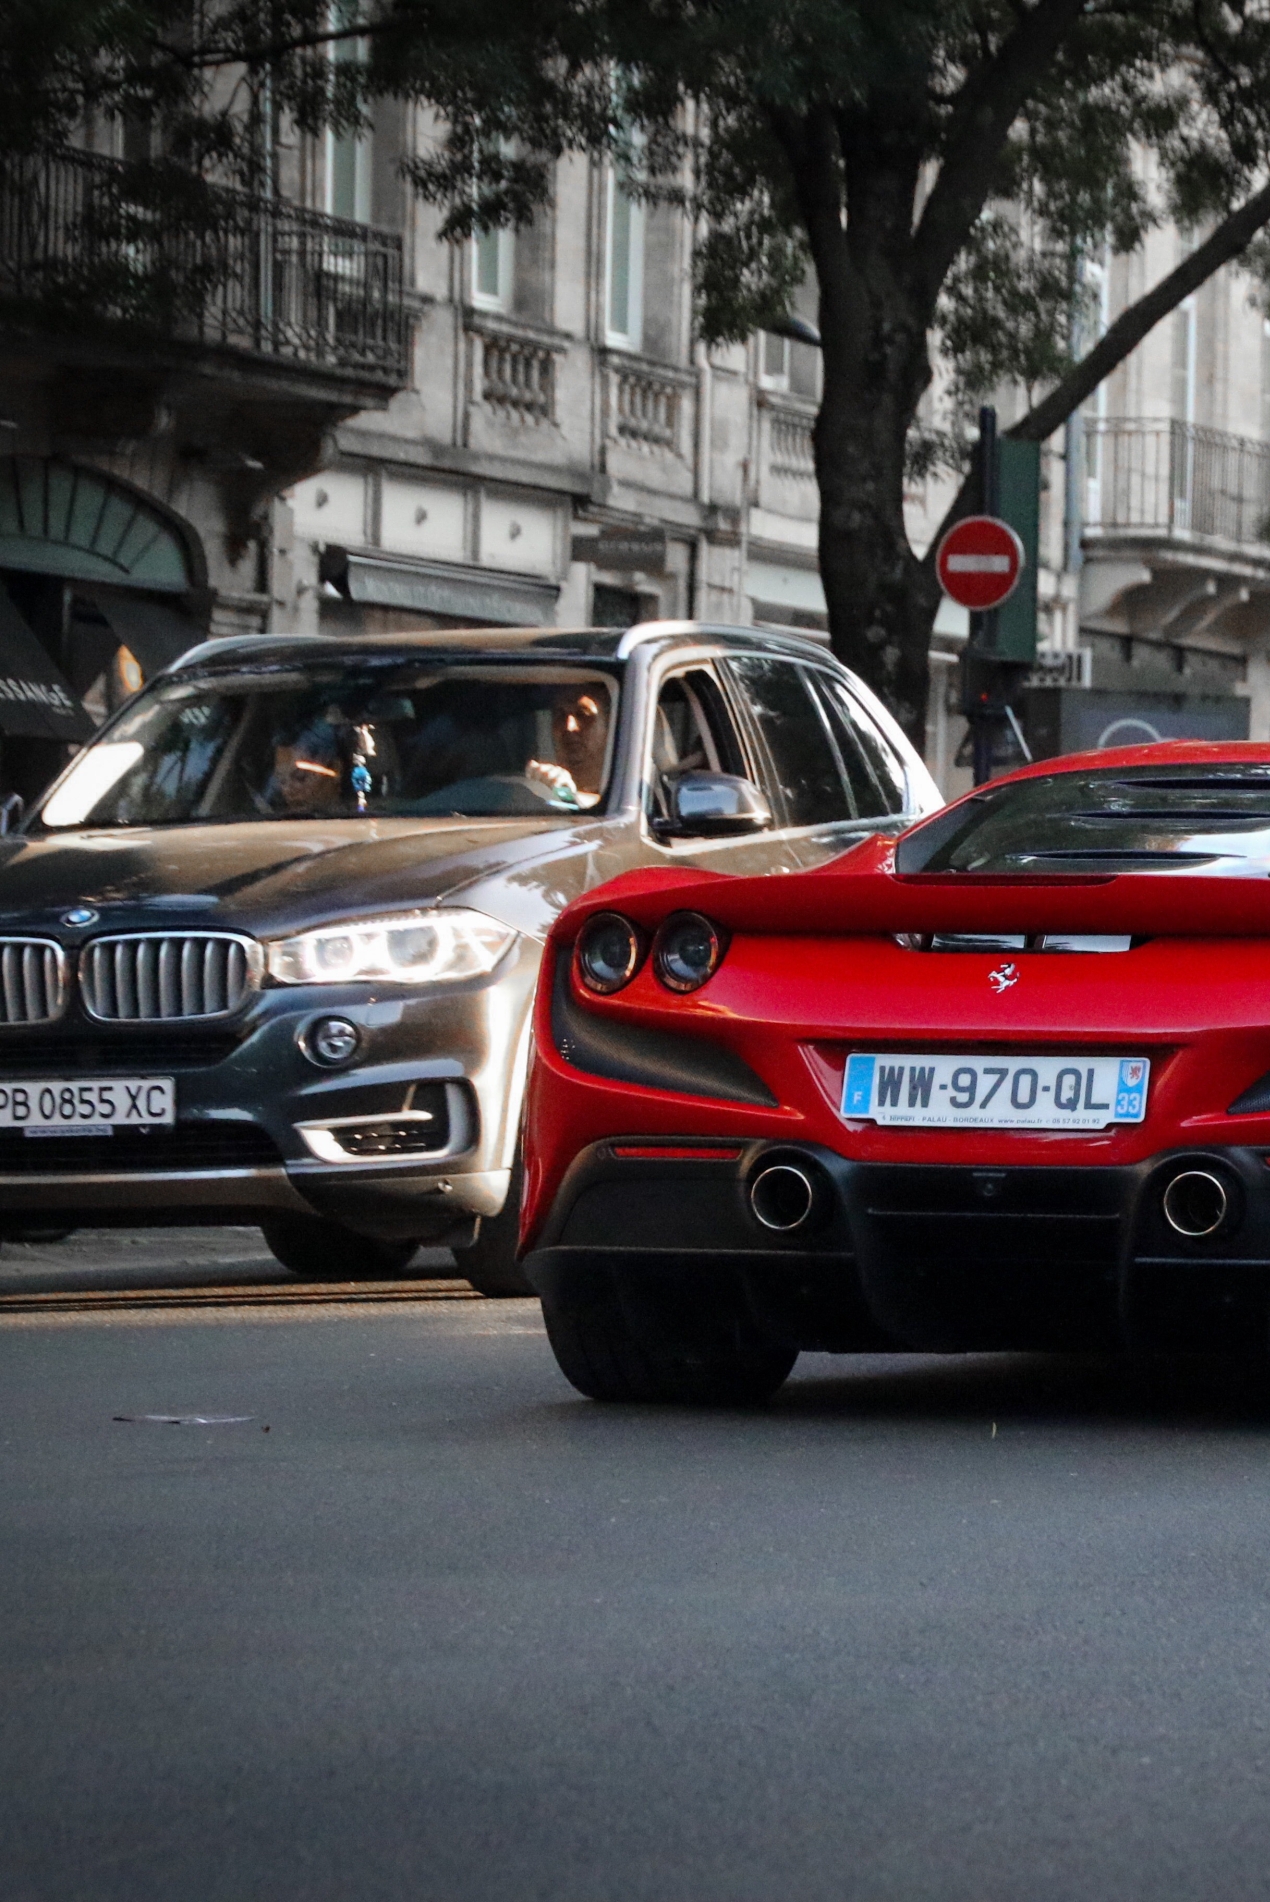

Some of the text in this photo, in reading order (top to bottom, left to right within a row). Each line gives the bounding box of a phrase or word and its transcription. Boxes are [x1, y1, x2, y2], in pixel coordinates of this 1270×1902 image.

[0, 678, 73, 707] SSANGE
[39, 1087, 116, 1120] 0855
[125, 1085, 166, 1118] XC
[853, 1091, 863, 1104] F
[876, 1065, 1110, 1112] WW-970-QL
[1116, 1092, 1141, 1114] 33
